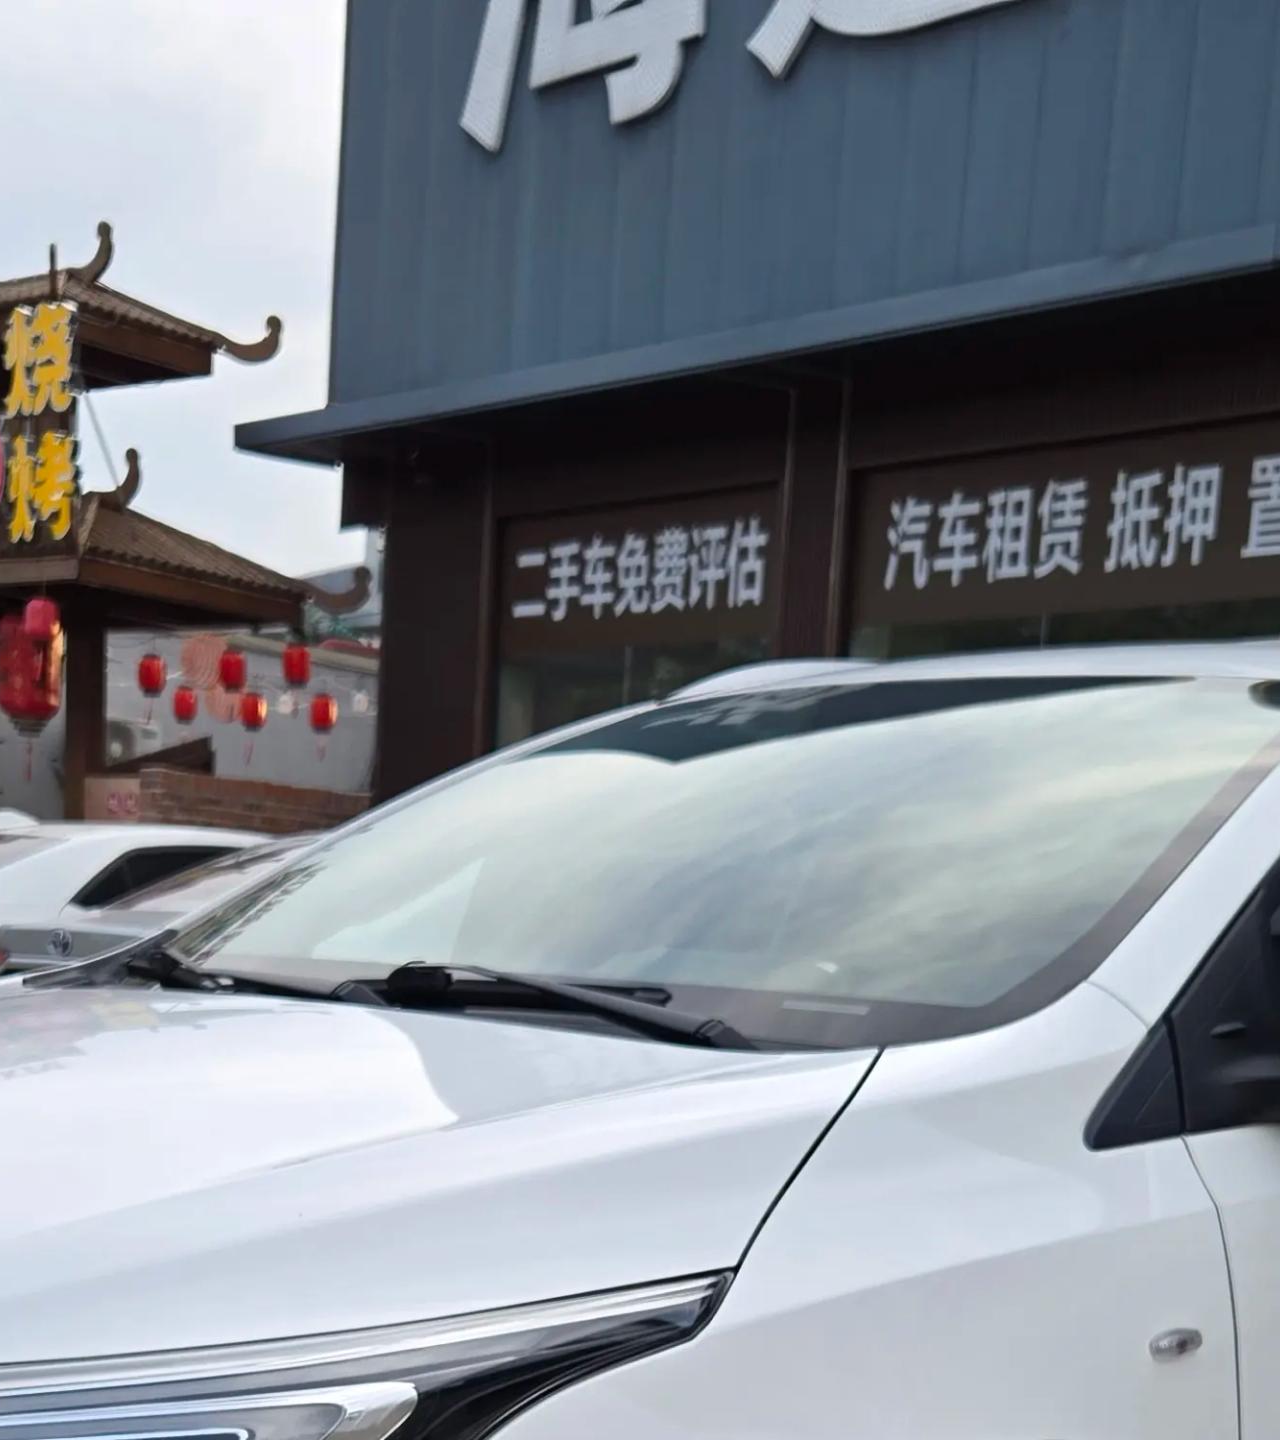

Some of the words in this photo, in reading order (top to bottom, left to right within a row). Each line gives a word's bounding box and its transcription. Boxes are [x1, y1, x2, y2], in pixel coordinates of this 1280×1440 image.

[4, 301, 80, 543] 烧烤
[512, 516, 769, 622] 二手车免费评估
[883, 477, 1089, 592] 汽车租赁
[1103, 463, 1224, 574] 抵押
